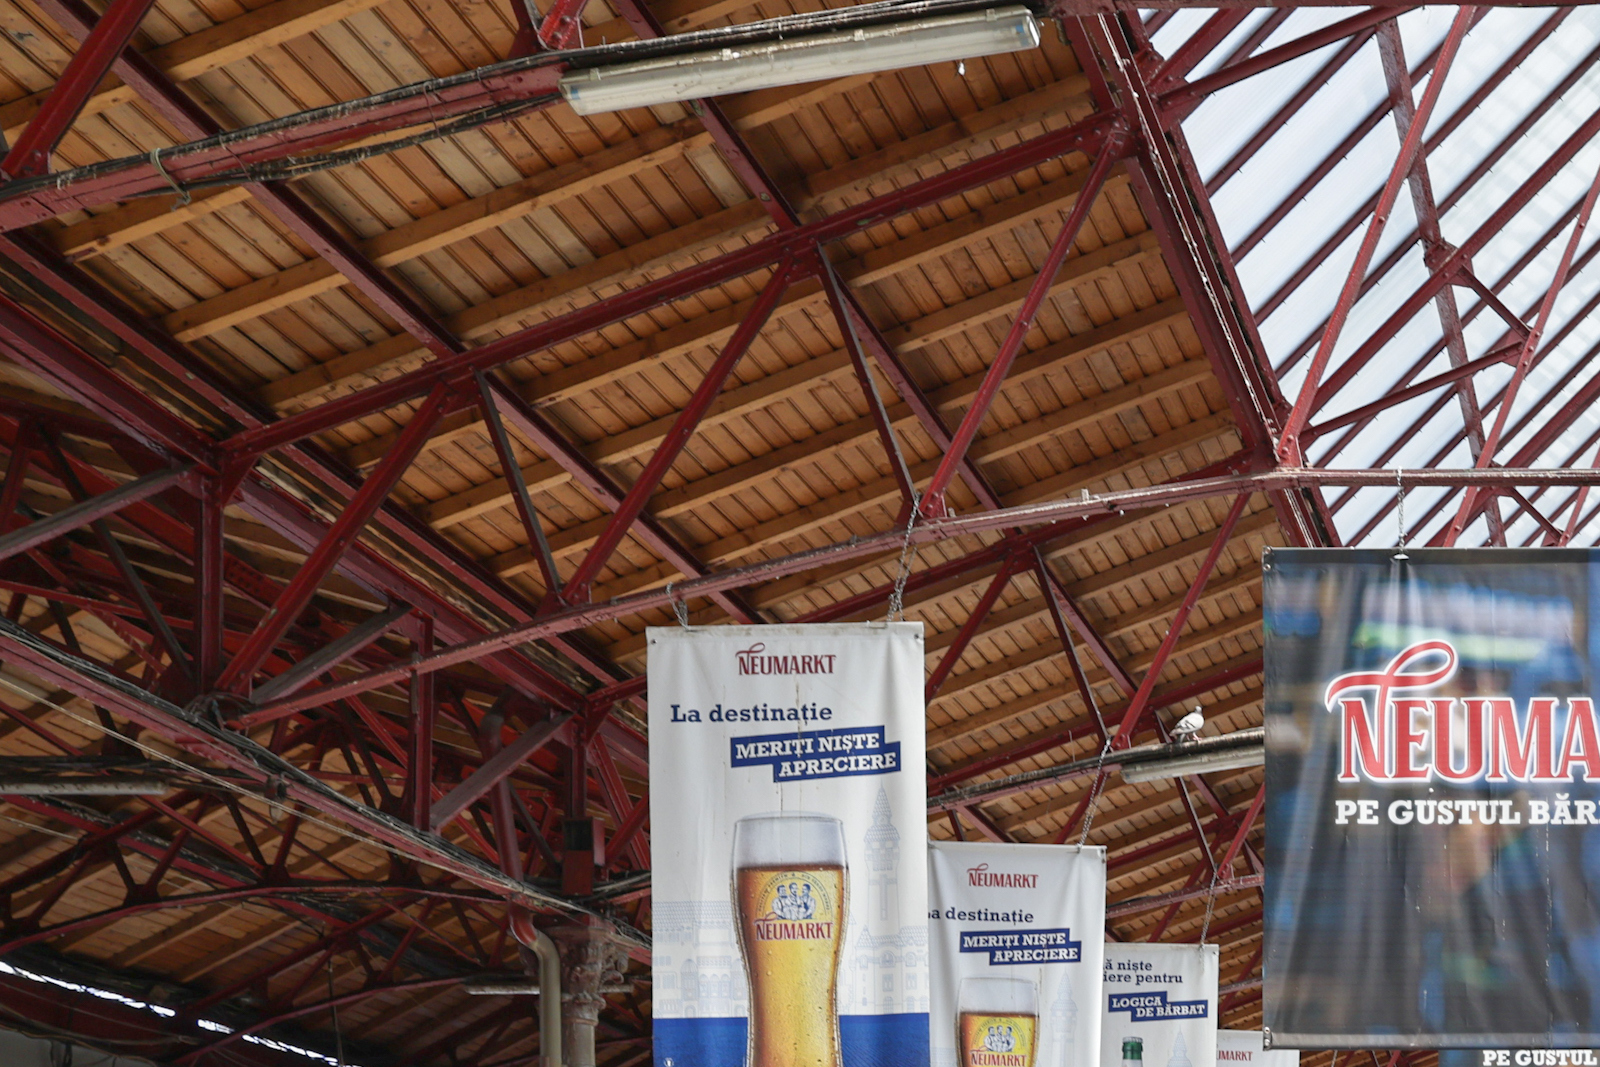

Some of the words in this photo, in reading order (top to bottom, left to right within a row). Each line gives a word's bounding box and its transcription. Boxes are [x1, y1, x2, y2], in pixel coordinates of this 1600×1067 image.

[735, 642, 836, 675] NEUMARKT
[670, 704, 702, 723] La
[709, 703, 833, 725] destinație
[735, 736, 815, 760] MERIȚI
[817, 732, 880, 754] NIȘTE
[778, 752, 896, 778] APRECIERE
[1335, 800, 1379, 824] PE
[1388, 799, 1521, 825] GUSTUL
[967, 863, 1039, 888] NEUMARKT
[945, 907, 1035, 925] destinație
[752, 911, 833, 940] NEUMARKT
[963, 934, 1020, 949] MERIȚI
[1022, 932, 1066, 946] NIȘTE
[993, 948, 1078, 962] APRECIERE
[1117, 960, 1153, 973] niște
[1135, 973, 1183, 985] pentru
[1112, 997, 1162, 1008] LOGICA
[1136, 1007, 1154, 1017] DE
[1156, 1003, 1205, 1017] BĂRBAT
[970, 1045, 1028, 1067] NEUMARKT
[1217, 1051, 1253, 1061] UMARKT
[1482, 1050, 1511, 1066] PE
[1514, 1050, 1597, 1067] GUSTUL
